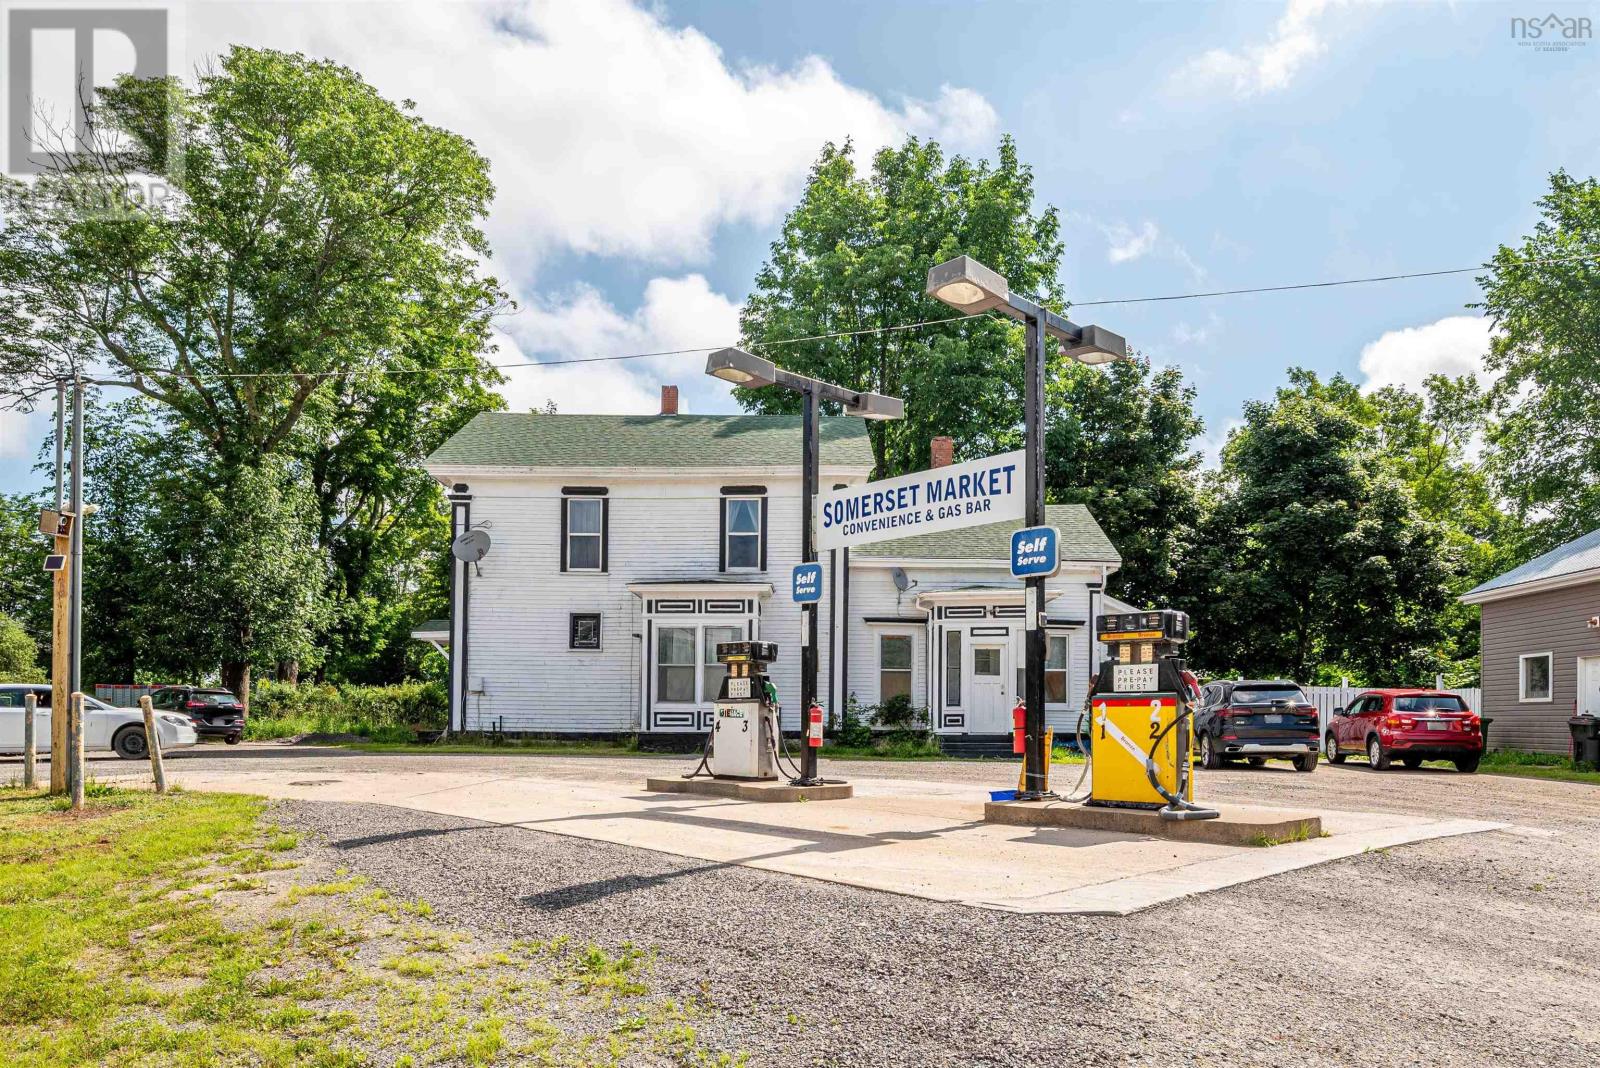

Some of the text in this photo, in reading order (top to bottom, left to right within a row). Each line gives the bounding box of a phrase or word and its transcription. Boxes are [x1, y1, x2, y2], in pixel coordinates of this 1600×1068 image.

[823, 465, 1016, 528] SOMERSET MARKET
[842, 498, 992, 536] CONVENIENCE & GAS BAR
[1016, 536, 1048, 555] Self
[1016, 555, 1048, 567] Serve
[796, 570, 816, 585] Self
[796, 585, 816, 594] Serve
[1098, 700, 1162, 722] 1 2
[715, 720, 749, 733] 4 3
[1149, 722, 1161, 740] 2
